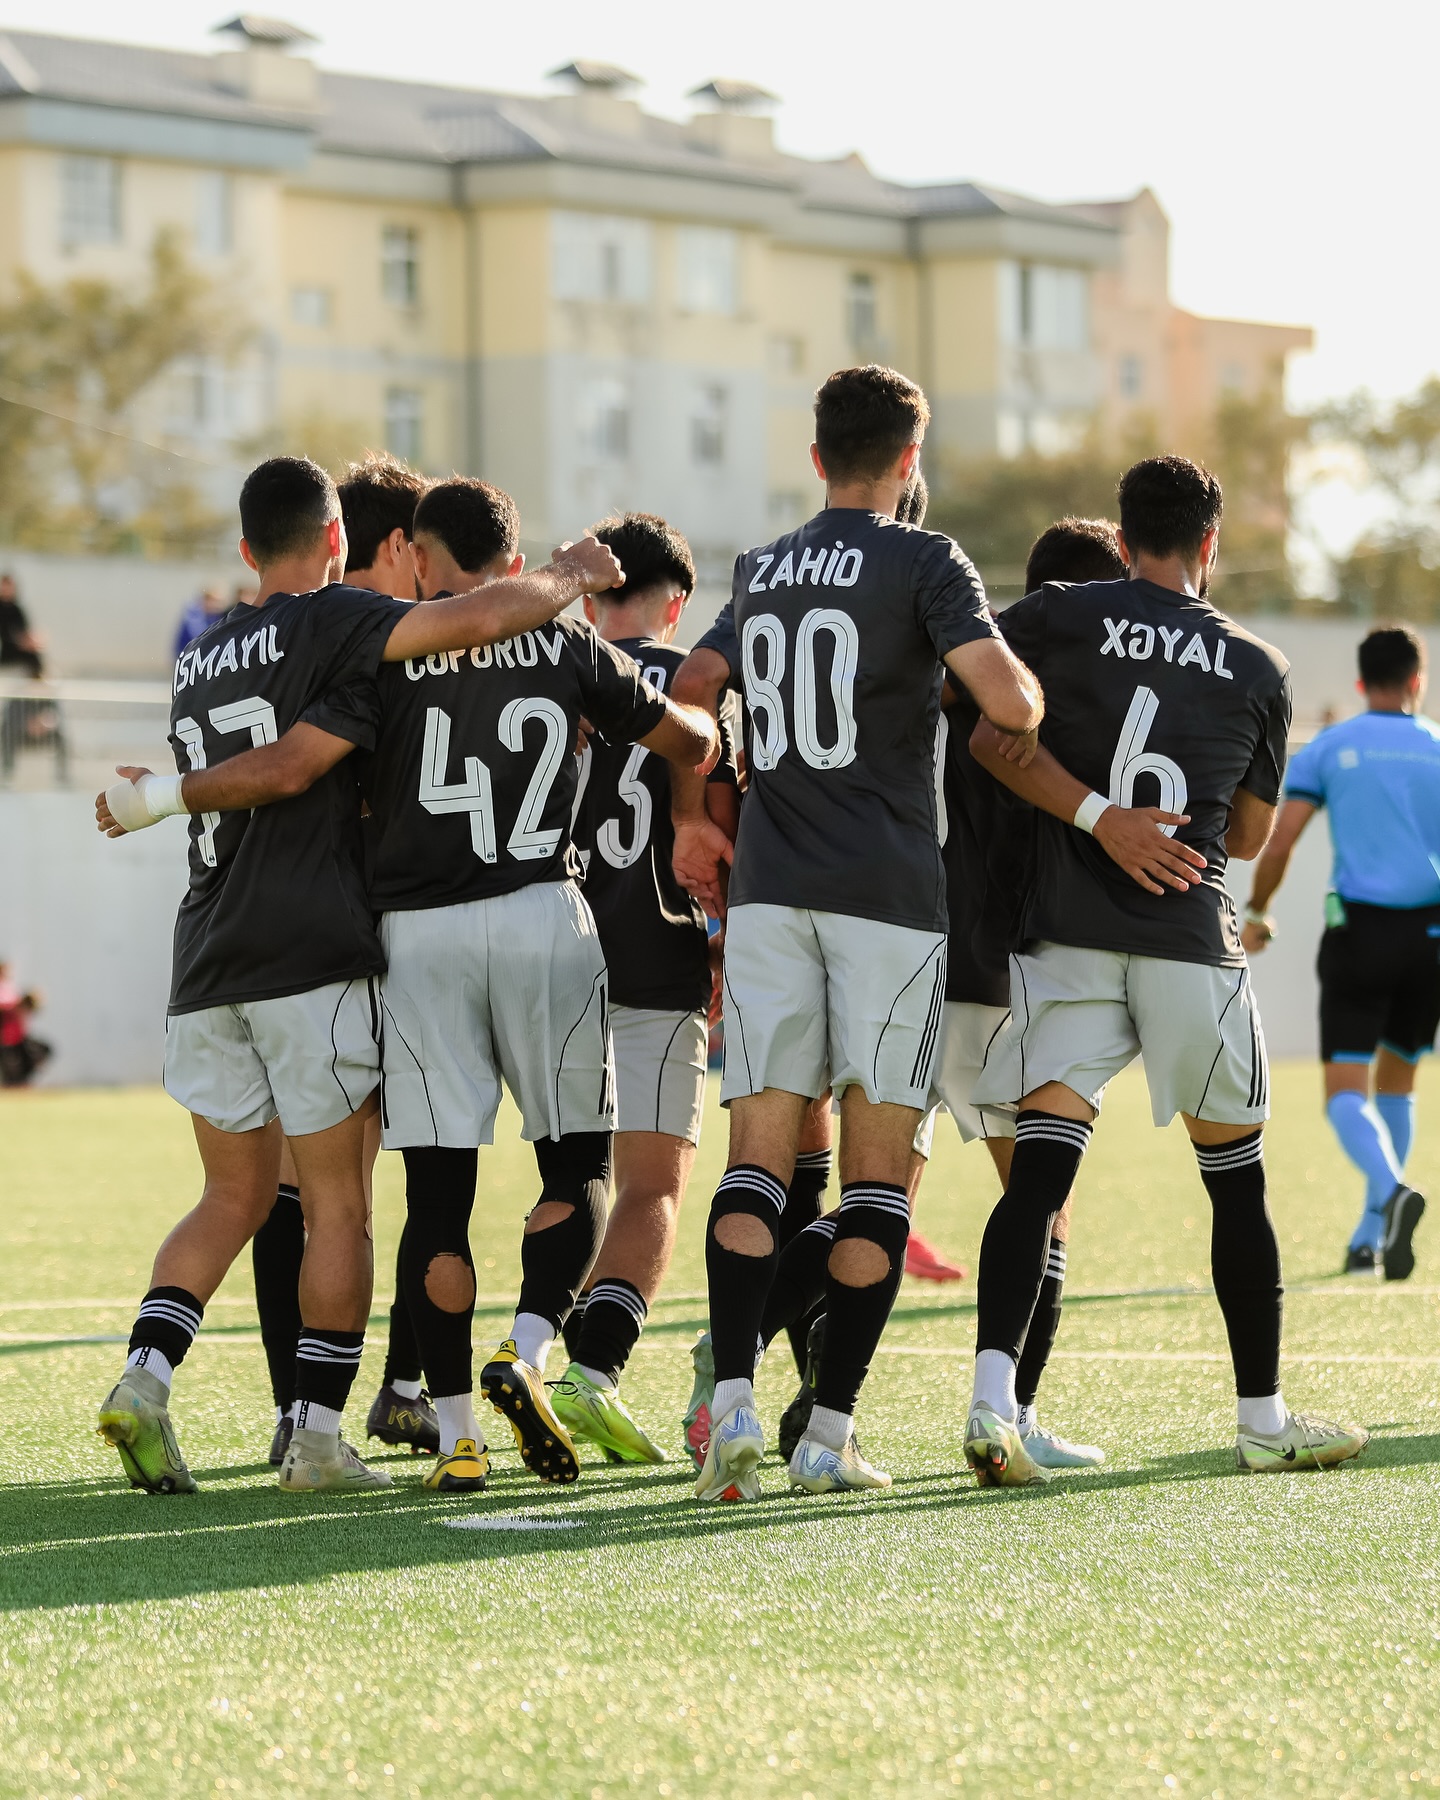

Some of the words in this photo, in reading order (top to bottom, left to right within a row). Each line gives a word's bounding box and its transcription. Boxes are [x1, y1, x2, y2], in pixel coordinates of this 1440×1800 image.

[748, 540, 864, 594] ZAHİD
[742, 607, 859, 771] 80
[1100, 617, 1235, 681] XƏYAL
[418, 697, 568, 864] 42
[1108, 685, 1188, 839] 6
